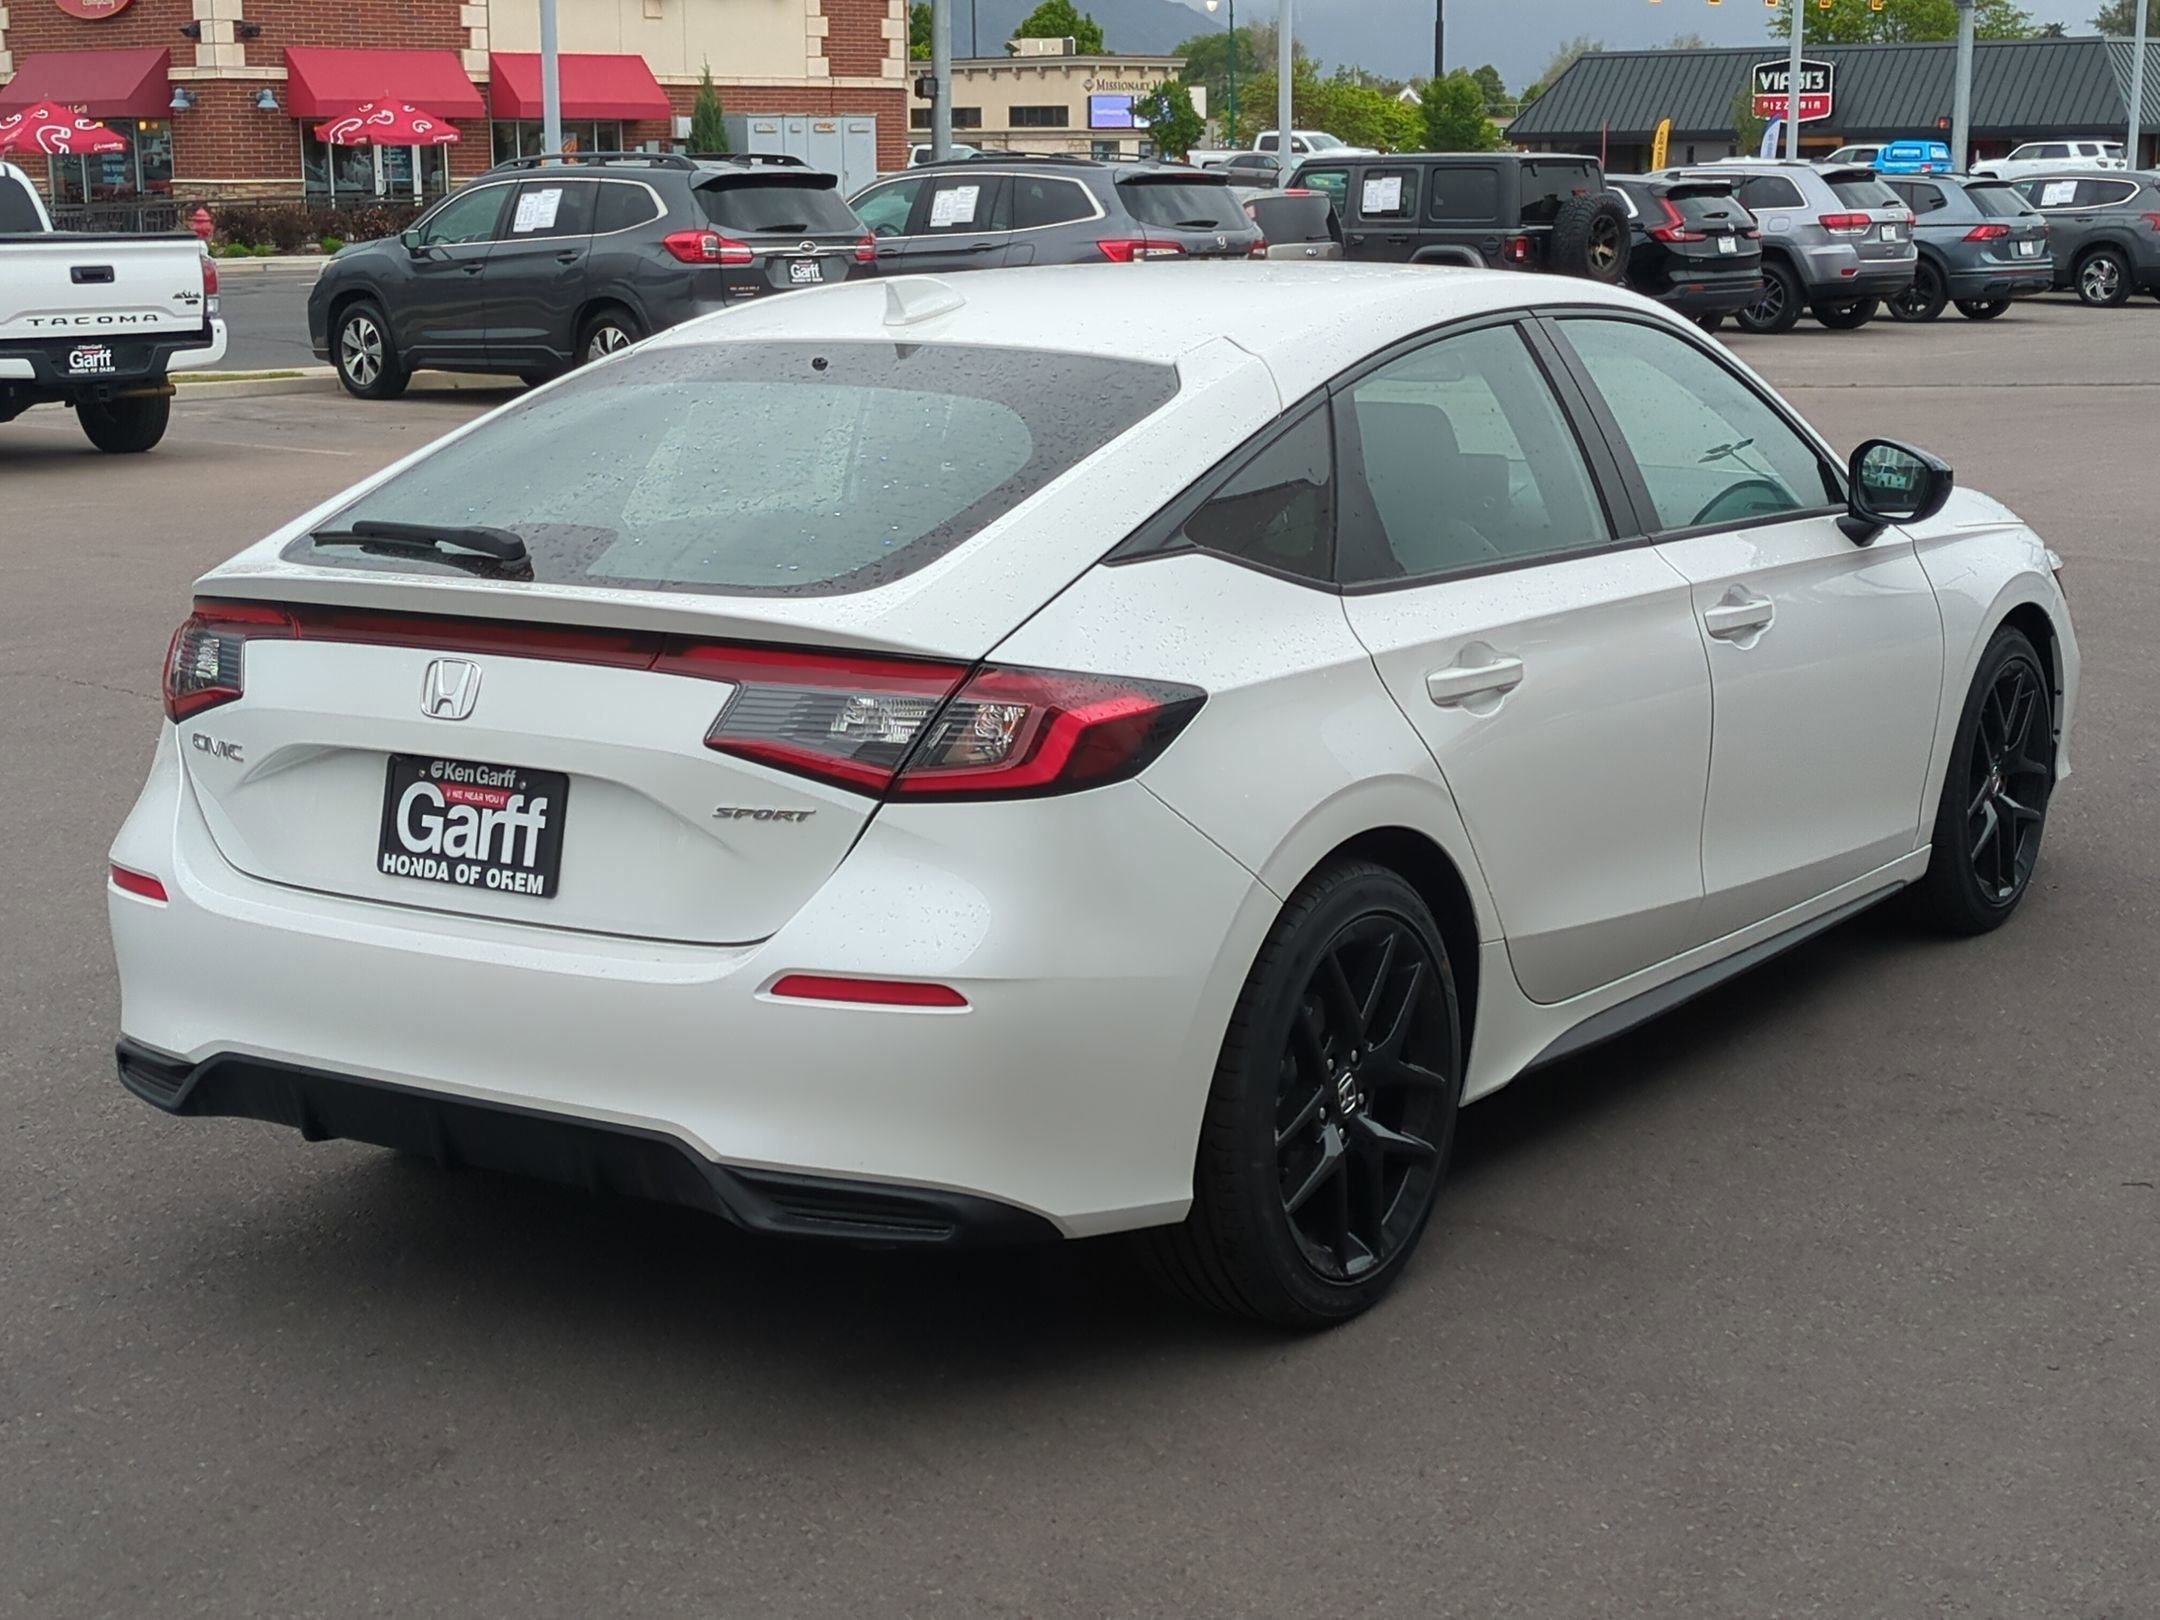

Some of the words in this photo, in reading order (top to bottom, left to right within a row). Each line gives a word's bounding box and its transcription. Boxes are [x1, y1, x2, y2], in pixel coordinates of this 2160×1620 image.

[1096, 79, 1150, 91] MISSIONARY
[1762, 100, 1821, 110] PIZZRIA
[790, 263, 820, 279] Garff
[26, 314, 159, 327] TACOMA
[69, 349, 112, 369] Garff
[192, 732, 244, 763] CIVIC
[444, 761, 474, 783] Ken
[475, 766, 517, 788] Garff
[464, 791, 484, 802] HEAR
[485, 793, 500, 805] YOU
[711, 807, 816, 822] SPORT
[396, 781, 548, 868] Garff
[382, 853, 450, 882] HONDA
[455, 863, 482, 885] OF
[486, 868, 545, 895] OREM
